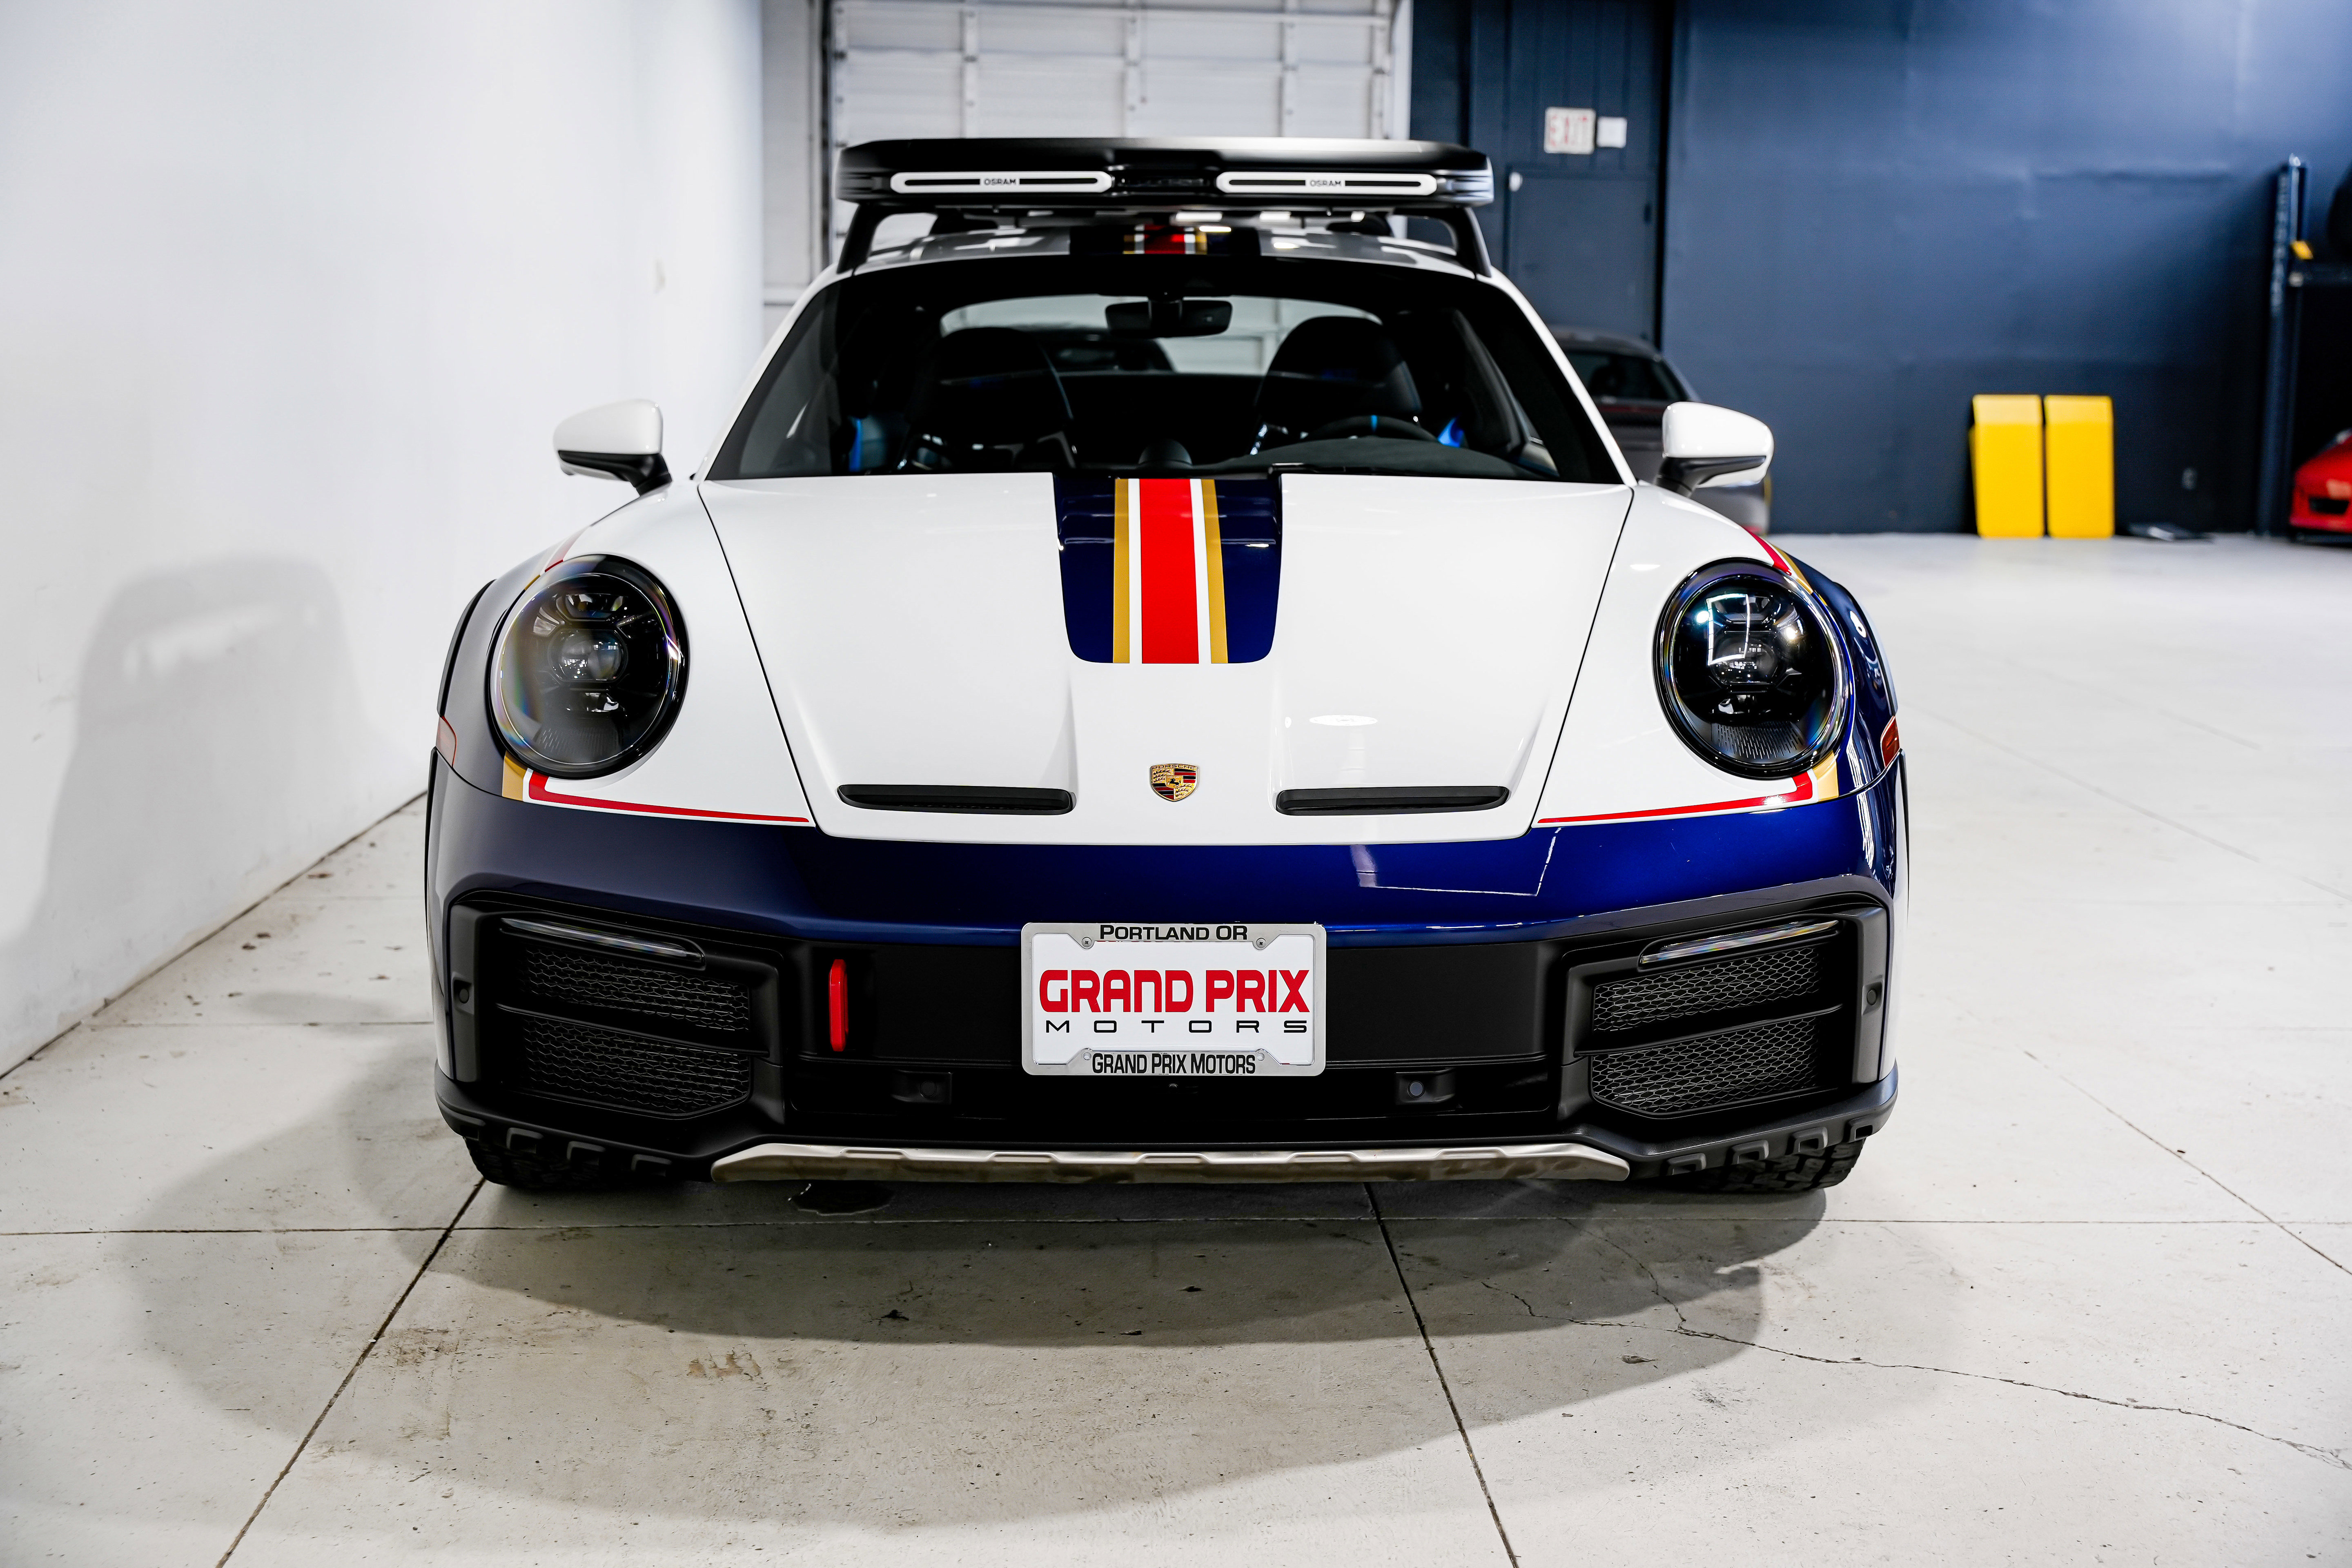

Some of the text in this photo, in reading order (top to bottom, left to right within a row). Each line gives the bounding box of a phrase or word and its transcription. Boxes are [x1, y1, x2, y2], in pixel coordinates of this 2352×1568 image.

[1100, 924, 1248, 941] PORTLAND OR
[1039, 969, 1310, 1013] GRAND PRIX
[1046, 1020, 1307, 1033] MOTORS
[1092, 1053, 1256, 1074] GRAND PRIX MOTORS
